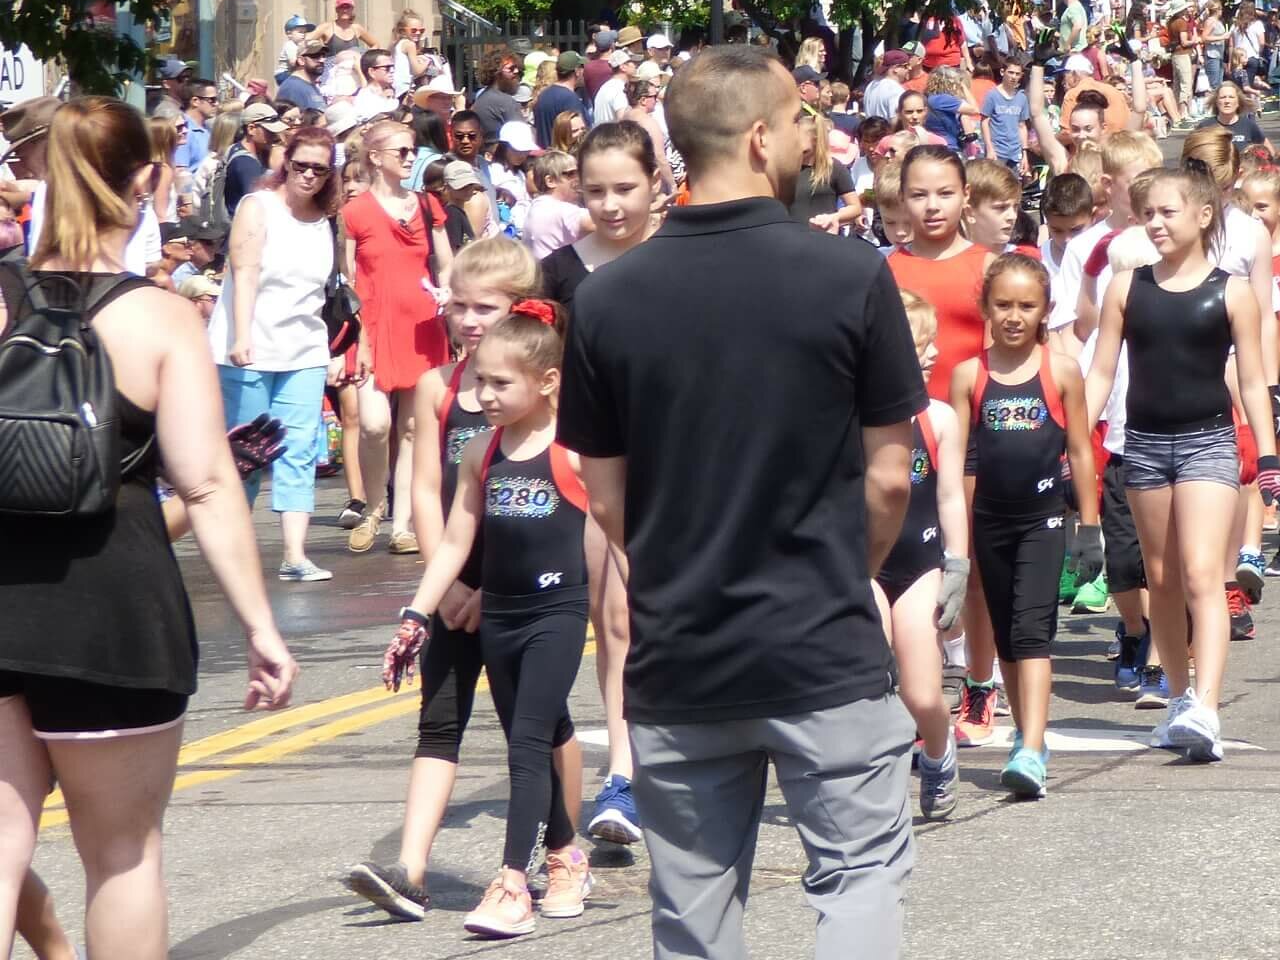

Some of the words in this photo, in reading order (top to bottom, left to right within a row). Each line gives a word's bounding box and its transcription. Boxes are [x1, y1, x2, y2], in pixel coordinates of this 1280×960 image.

[0, 55, 25, 91] AD
[986, 406, 1041, 424] 5280
[488, 487, 550, 507] 5280
